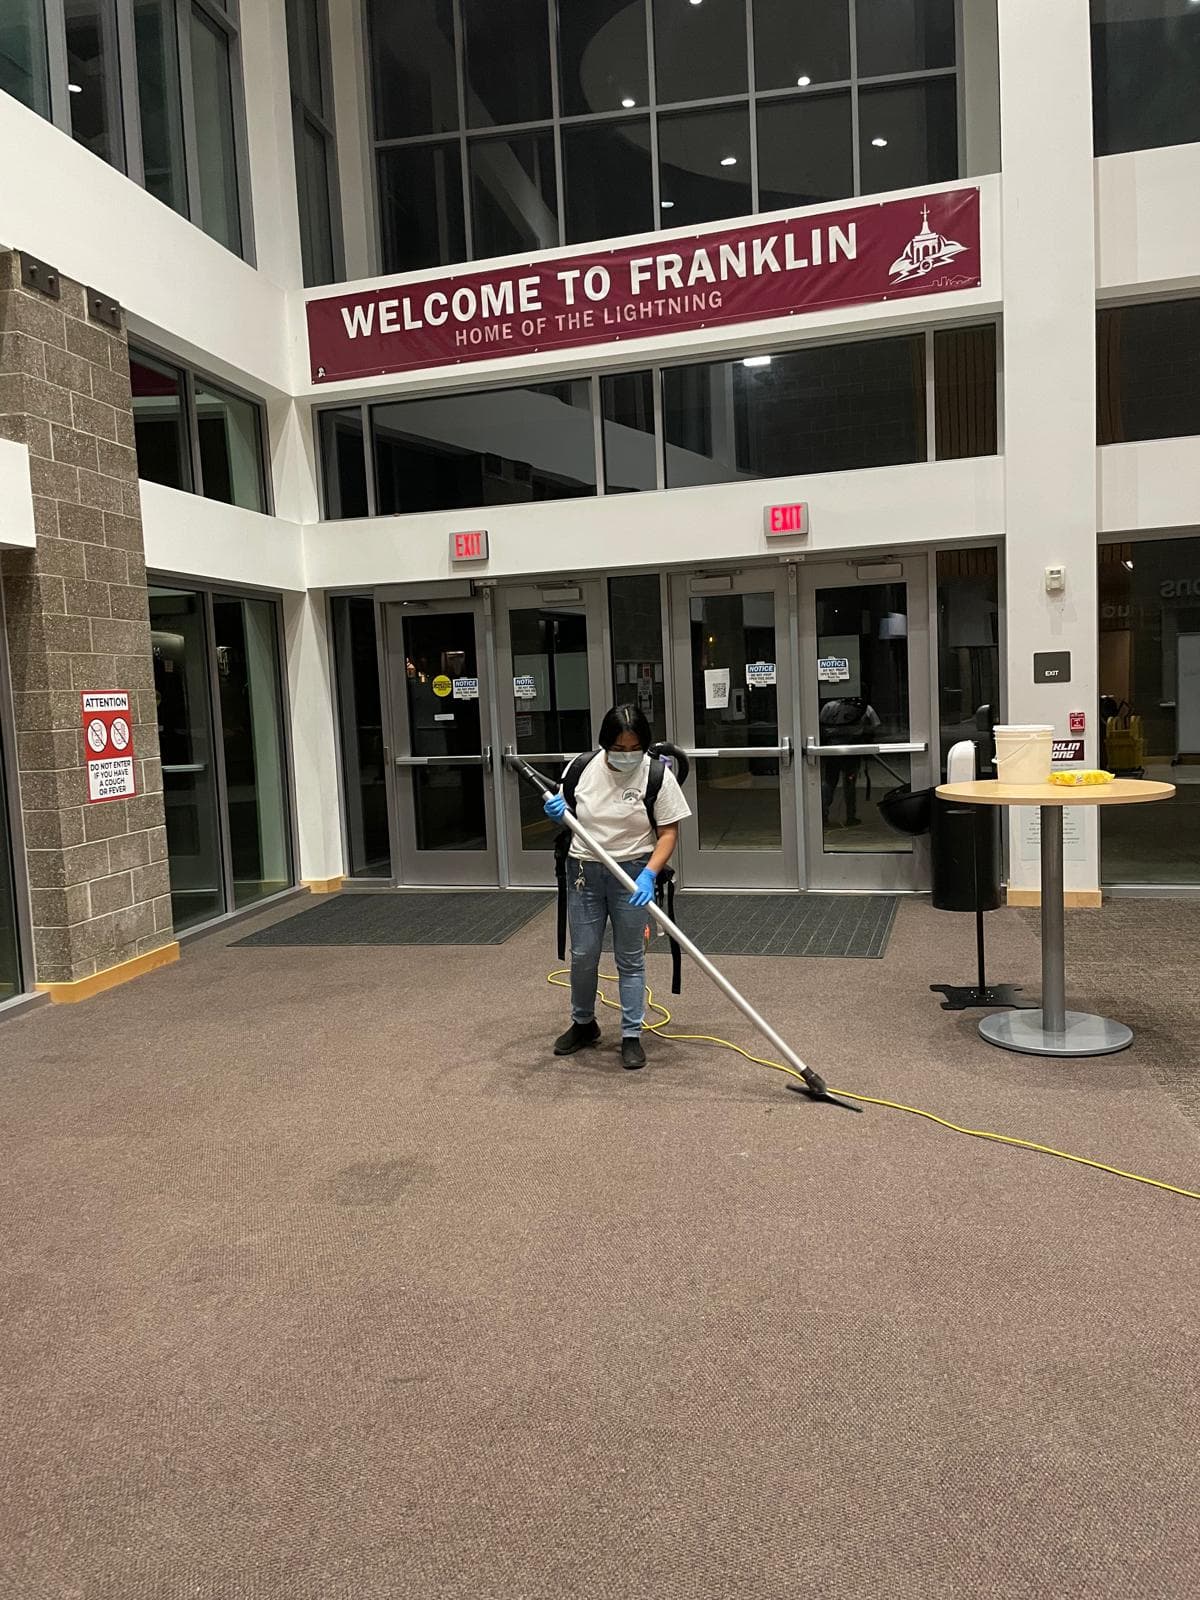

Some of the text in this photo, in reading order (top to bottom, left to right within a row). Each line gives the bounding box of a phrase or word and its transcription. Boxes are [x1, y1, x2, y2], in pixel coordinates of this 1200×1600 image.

[341, 222, 857, 339] WELCOME TO FRANKLIN
[455, 290, 723, 346] HOME OF THE LIGHTNING
[771, 504, 801, 531] EXIT
[455, 533, 481, 557] EXIT
[749, 665, 774, 673] NOTICE
[85, 697, 127, 708] ATTENTION
[101, 762, 112, 770] NOT
[113, 760, 131, 768] ENTER
[101, 770, 112, 778] YOU
[114, 768, 129, 777] HAVE
[99, 777, 125, 787] A COUGH
[99, 785, 126, 796] OR FEVER
